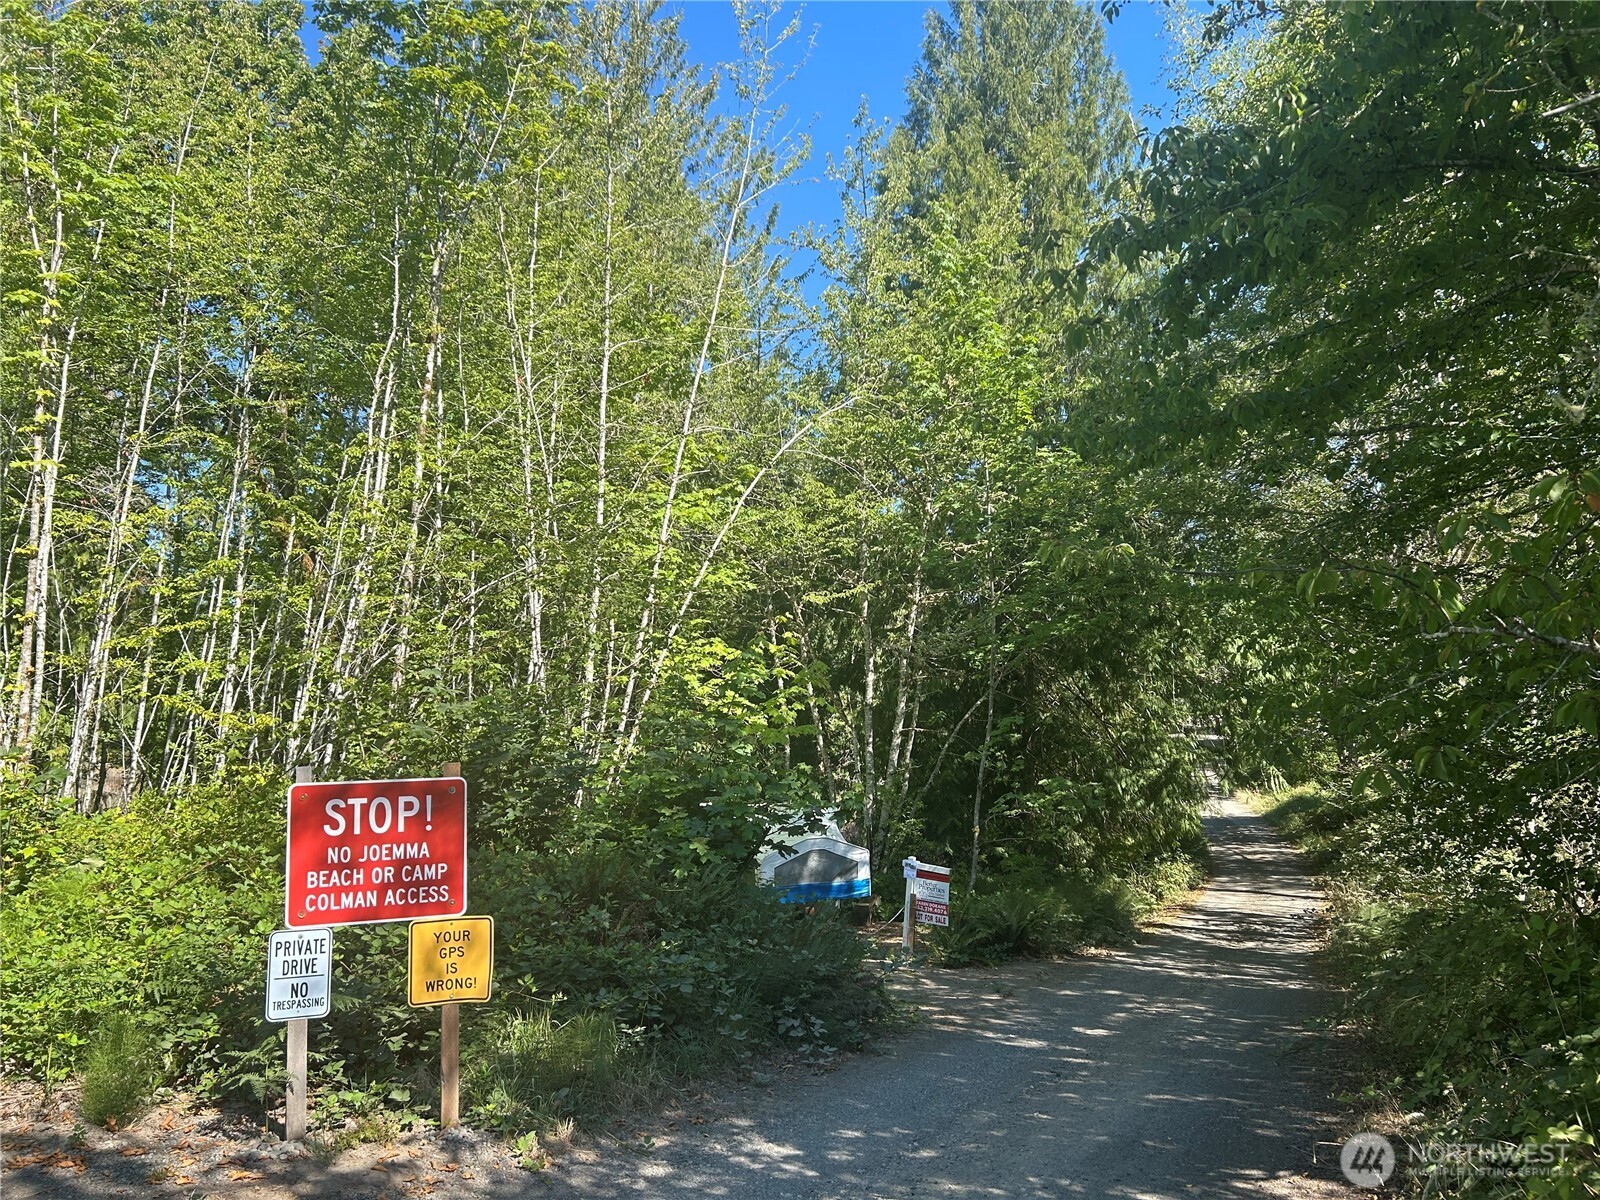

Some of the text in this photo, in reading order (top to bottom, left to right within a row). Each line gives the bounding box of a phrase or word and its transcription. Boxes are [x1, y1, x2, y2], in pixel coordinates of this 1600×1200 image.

[323, 795, 432, 837] STOP!
[327, 842, 430, 864] NO JOEMMA
[307, 863, 448, 888] BEACH OR CAMP
[919, 884, 946, 893] Properties
[305, 885, 449, 912] COLMAN ACCESS
[924, 914, 934, 922] FOR
[935, 916, 946, 924] SALE
[433, 930, 471, 943] YOUR
[275, 938, 326, 957] PRIVATE
[439, 946, 465, 959] GPS
[282, 957, 318, 976] DRIVE
[446, 962, 458, 974] IS
[290, 982, 308, 998] NO
[425, 977, 477, 992] WRONG!
[272, 997, 325, 1011] TRESPASSING
